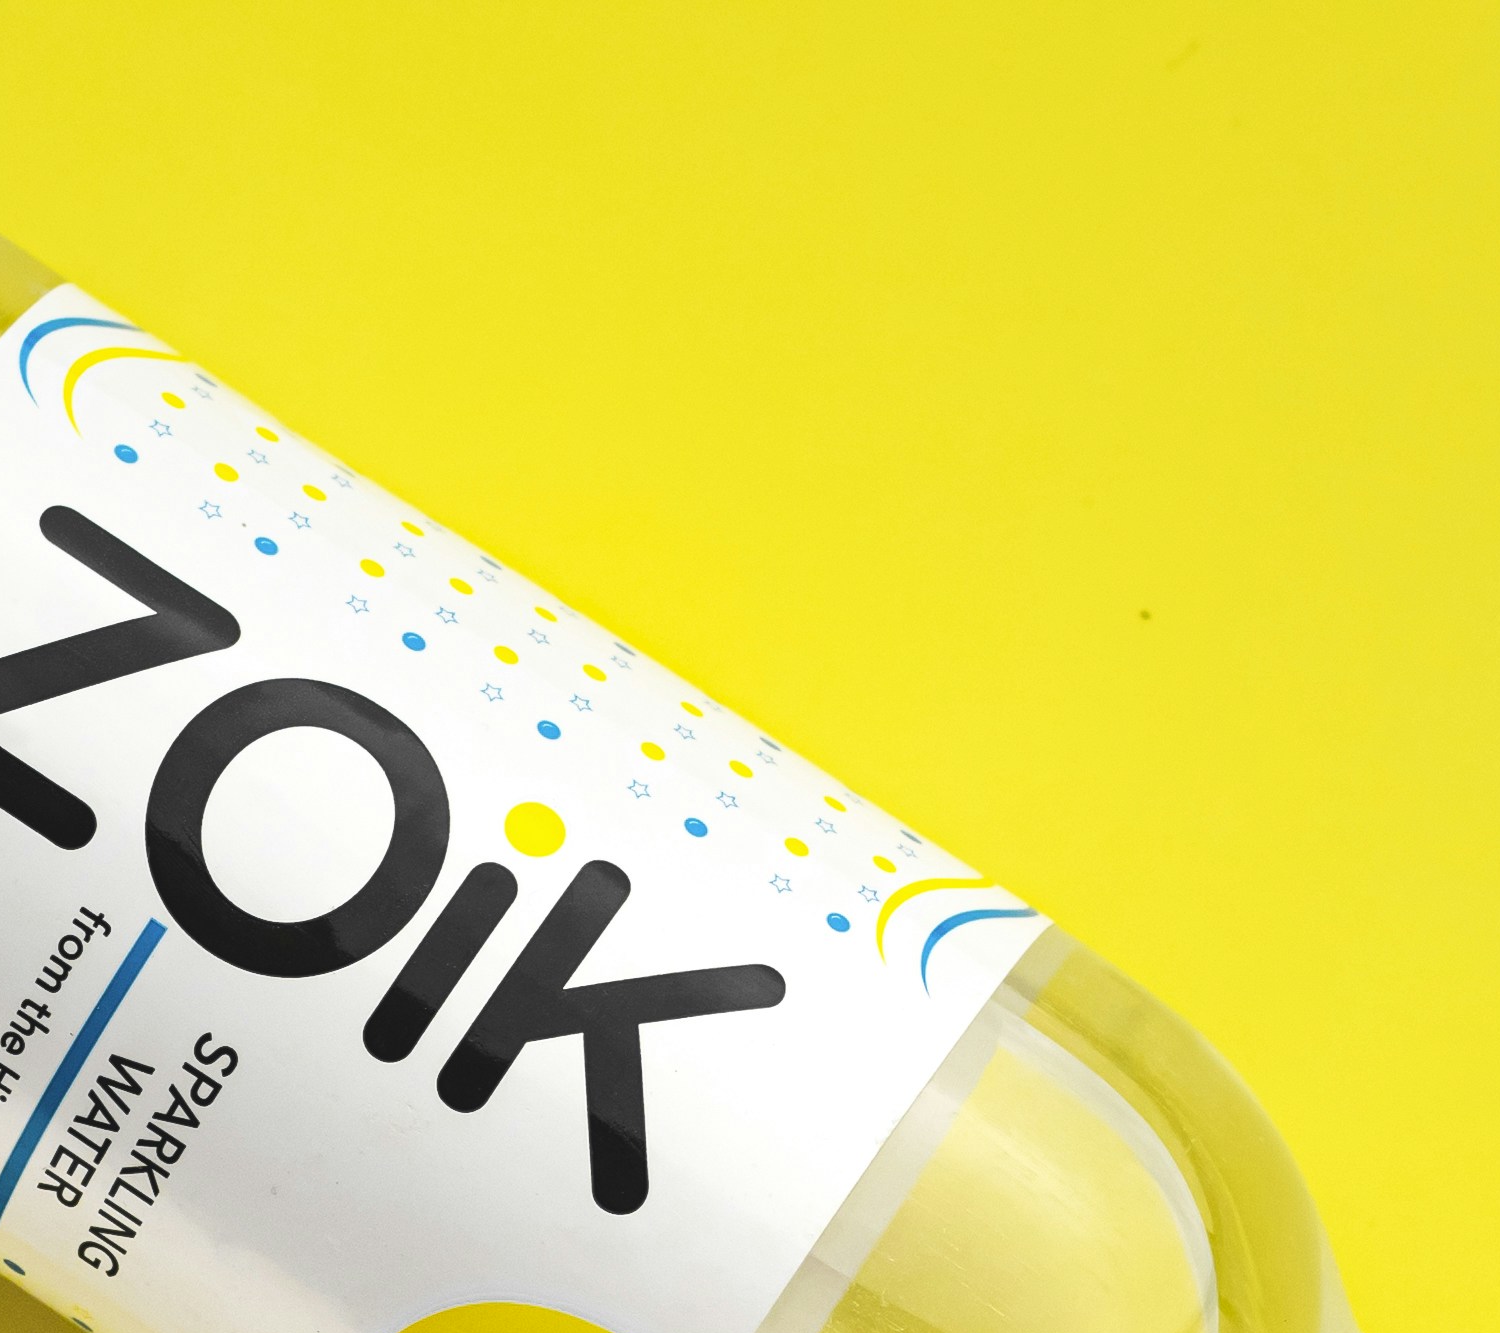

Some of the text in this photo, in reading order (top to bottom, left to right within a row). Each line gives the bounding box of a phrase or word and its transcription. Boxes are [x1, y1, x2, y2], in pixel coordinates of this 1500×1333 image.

[34, 905, 114, 995] from
[0, 997, 53, 1057] the
[35, 1053, 156, 1209] WATER
[77, 1030, 240, 1279] SPARKLING
